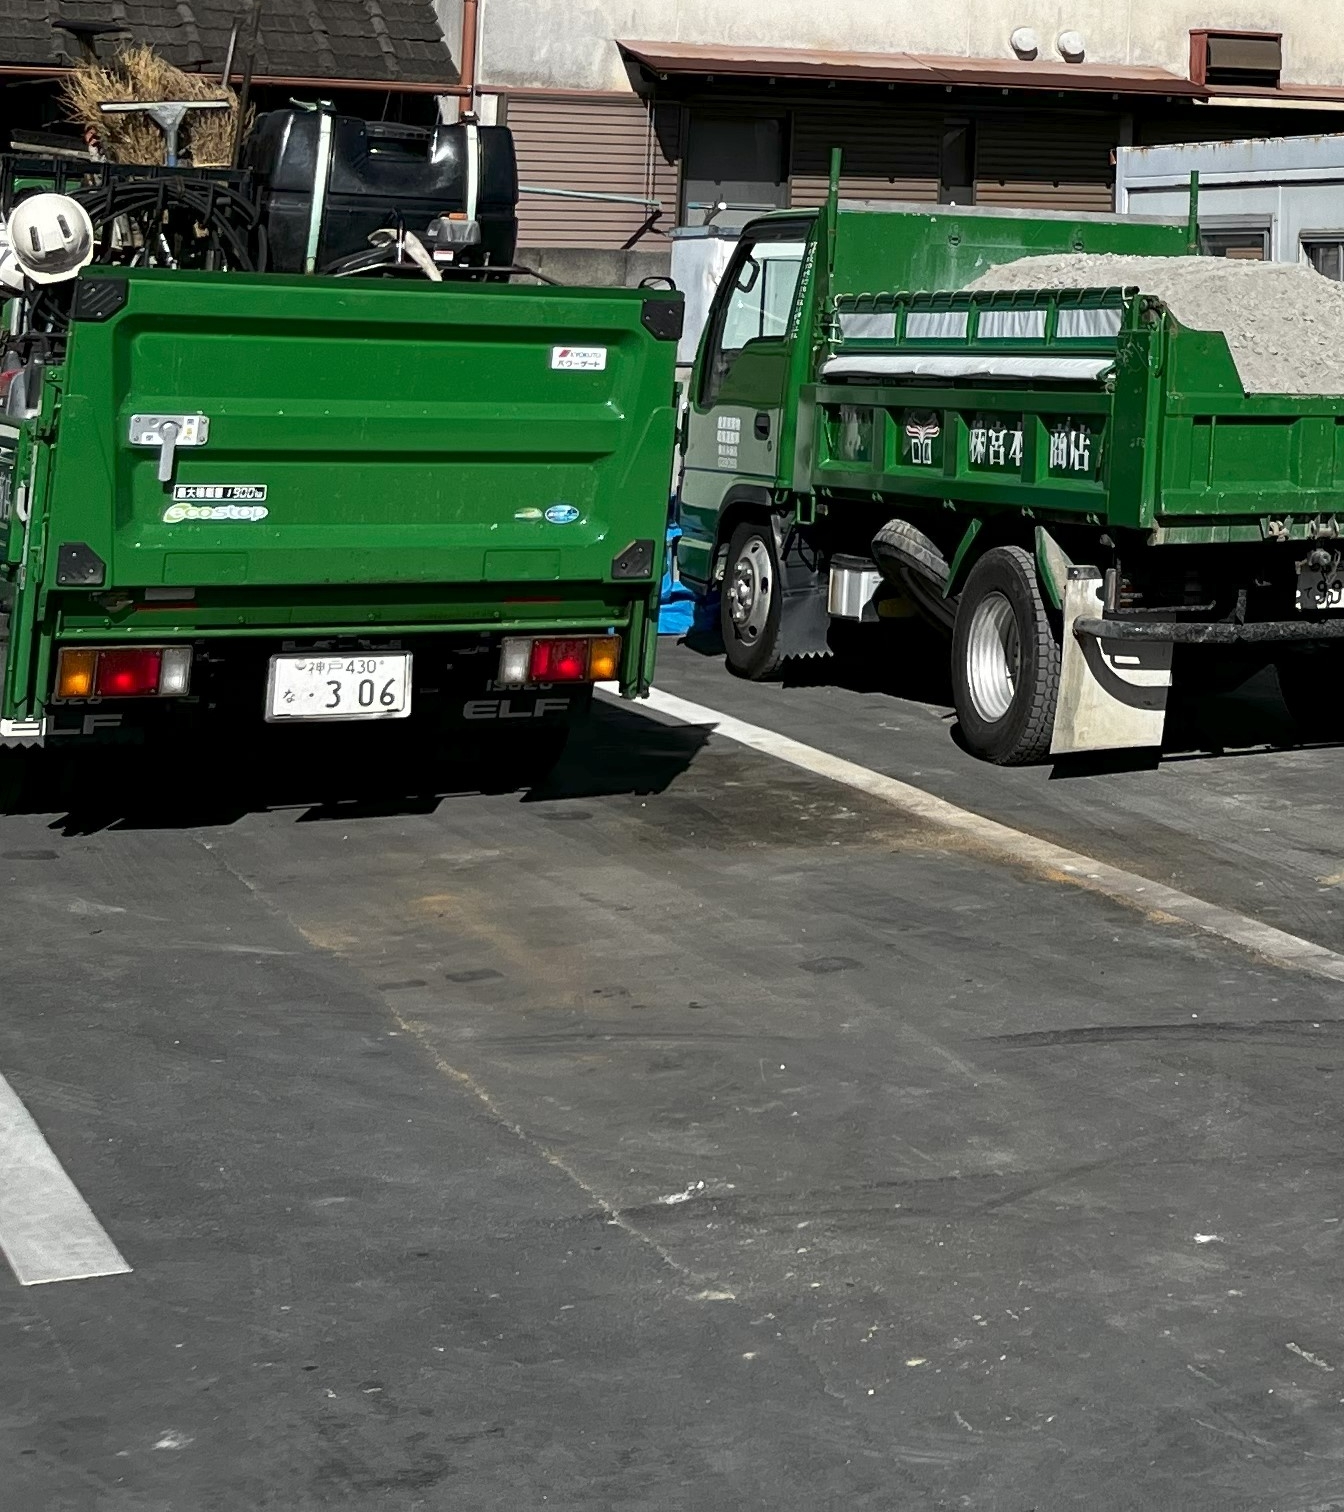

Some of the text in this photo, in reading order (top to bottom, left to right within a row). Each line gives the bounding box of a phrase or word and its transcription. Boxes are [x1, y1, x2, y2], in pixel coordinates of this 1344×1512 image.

[164, 503, 268, 522] ecostop
[283, 689, 296, 703] な
[463, 698, 570, 719] ELF
